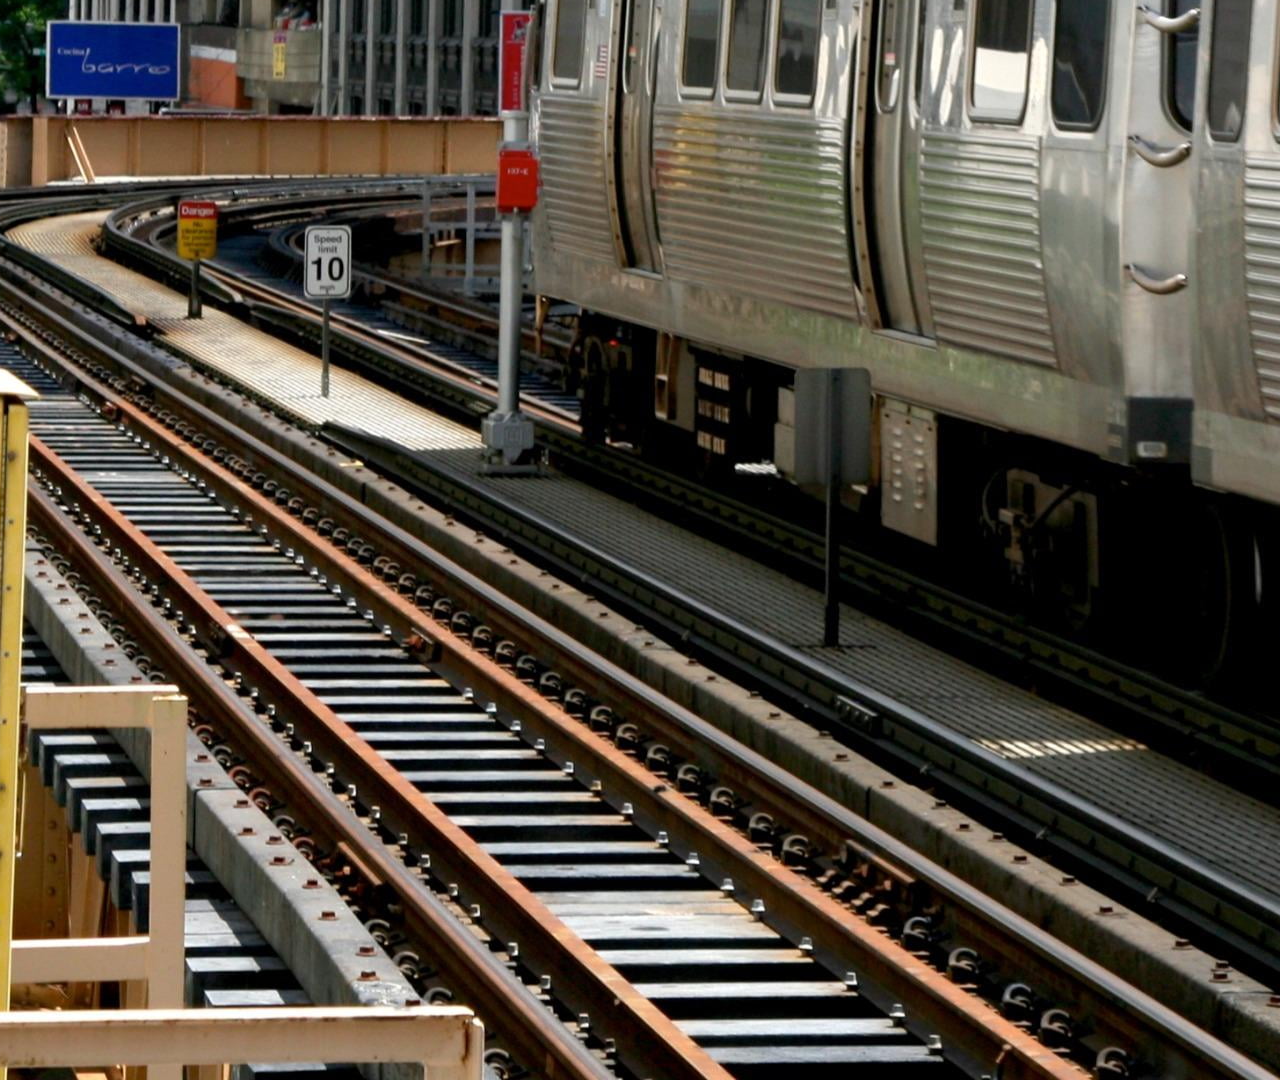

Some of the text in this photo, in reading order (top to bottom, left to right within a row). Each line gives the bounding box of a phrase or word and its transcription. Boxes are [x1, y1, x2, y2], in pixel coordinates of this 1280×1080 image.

[182, 206, 214, 217] Danger
[314, 235, 342, 243] Speed
[318, 245, 338, 253] limit
[311, 256, 344, 281] 10
